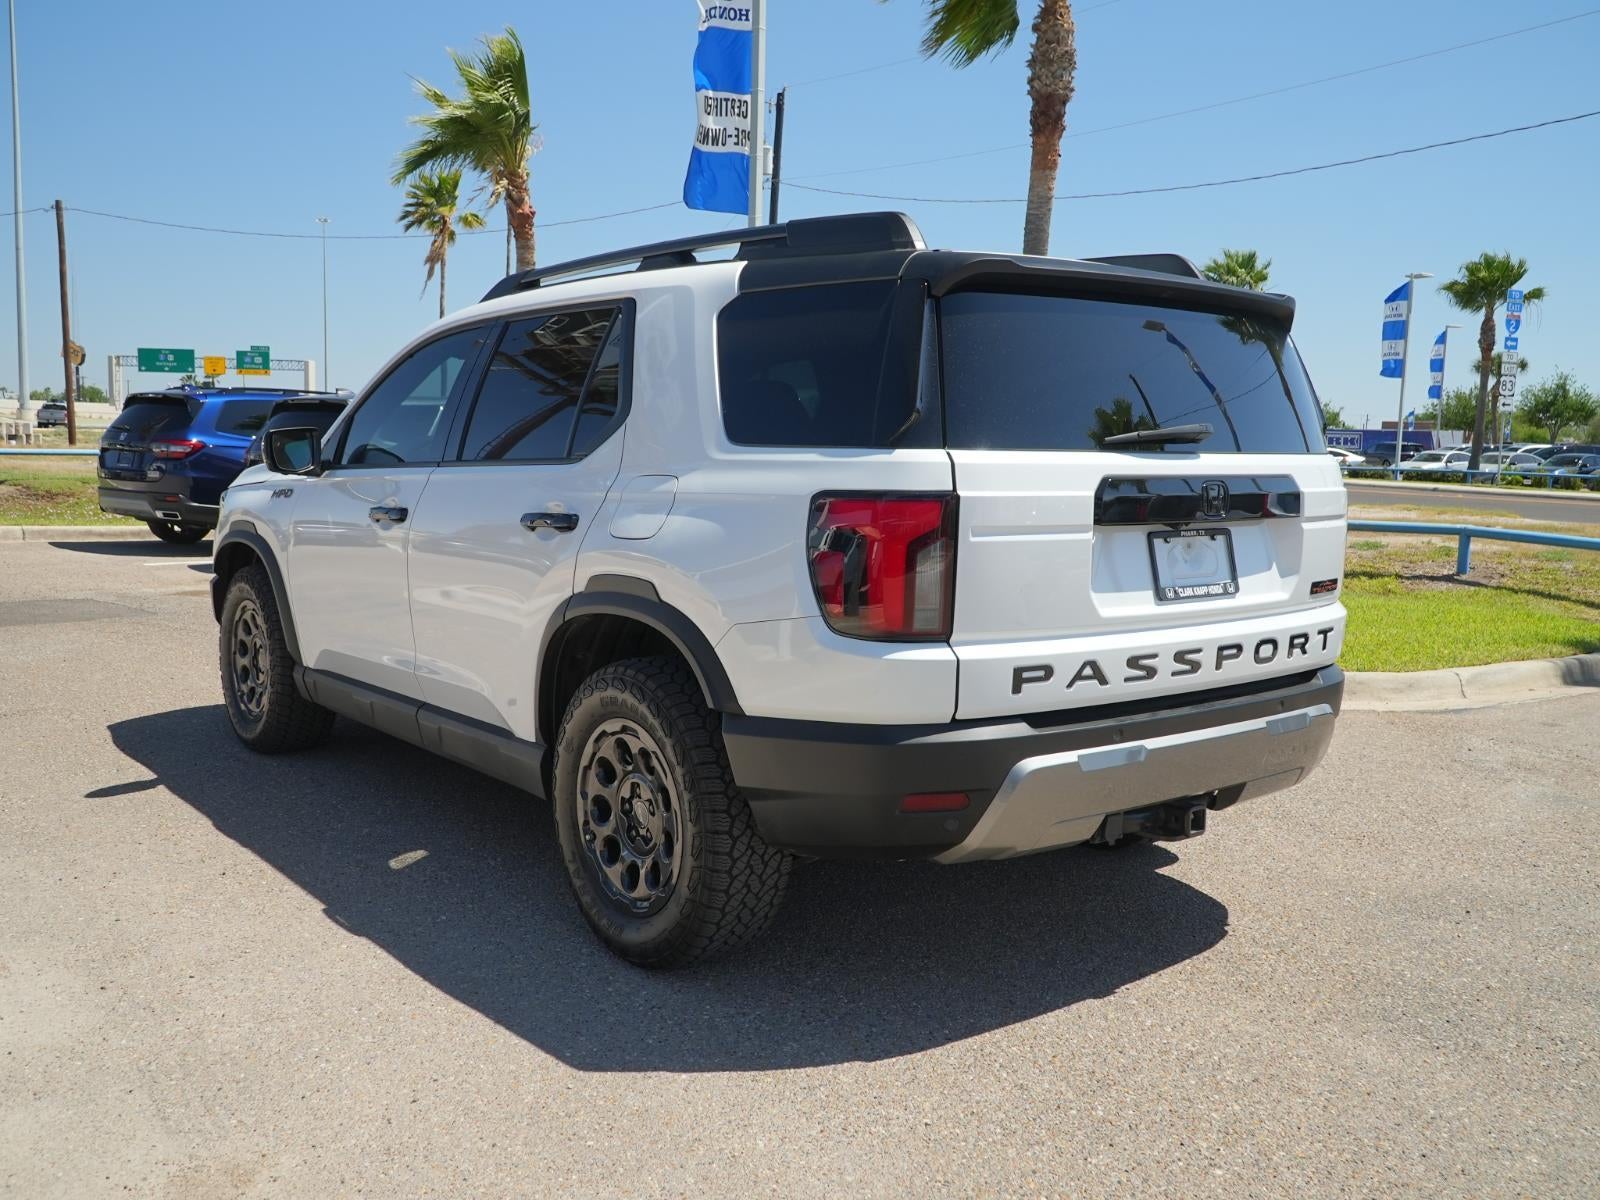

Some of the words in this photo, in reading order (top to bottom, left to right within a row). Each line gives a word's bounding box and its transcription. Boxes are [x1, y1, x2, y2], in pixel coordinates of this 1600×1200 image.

[1509, 321, 1516, 332] 2
[1501, 380, 1514, 392] 83
[270, 488, 294, 499] HPD
[1194, 585, 1208, 596] KNAPP
[1011, 627, 1335, 696] PASSPORT
